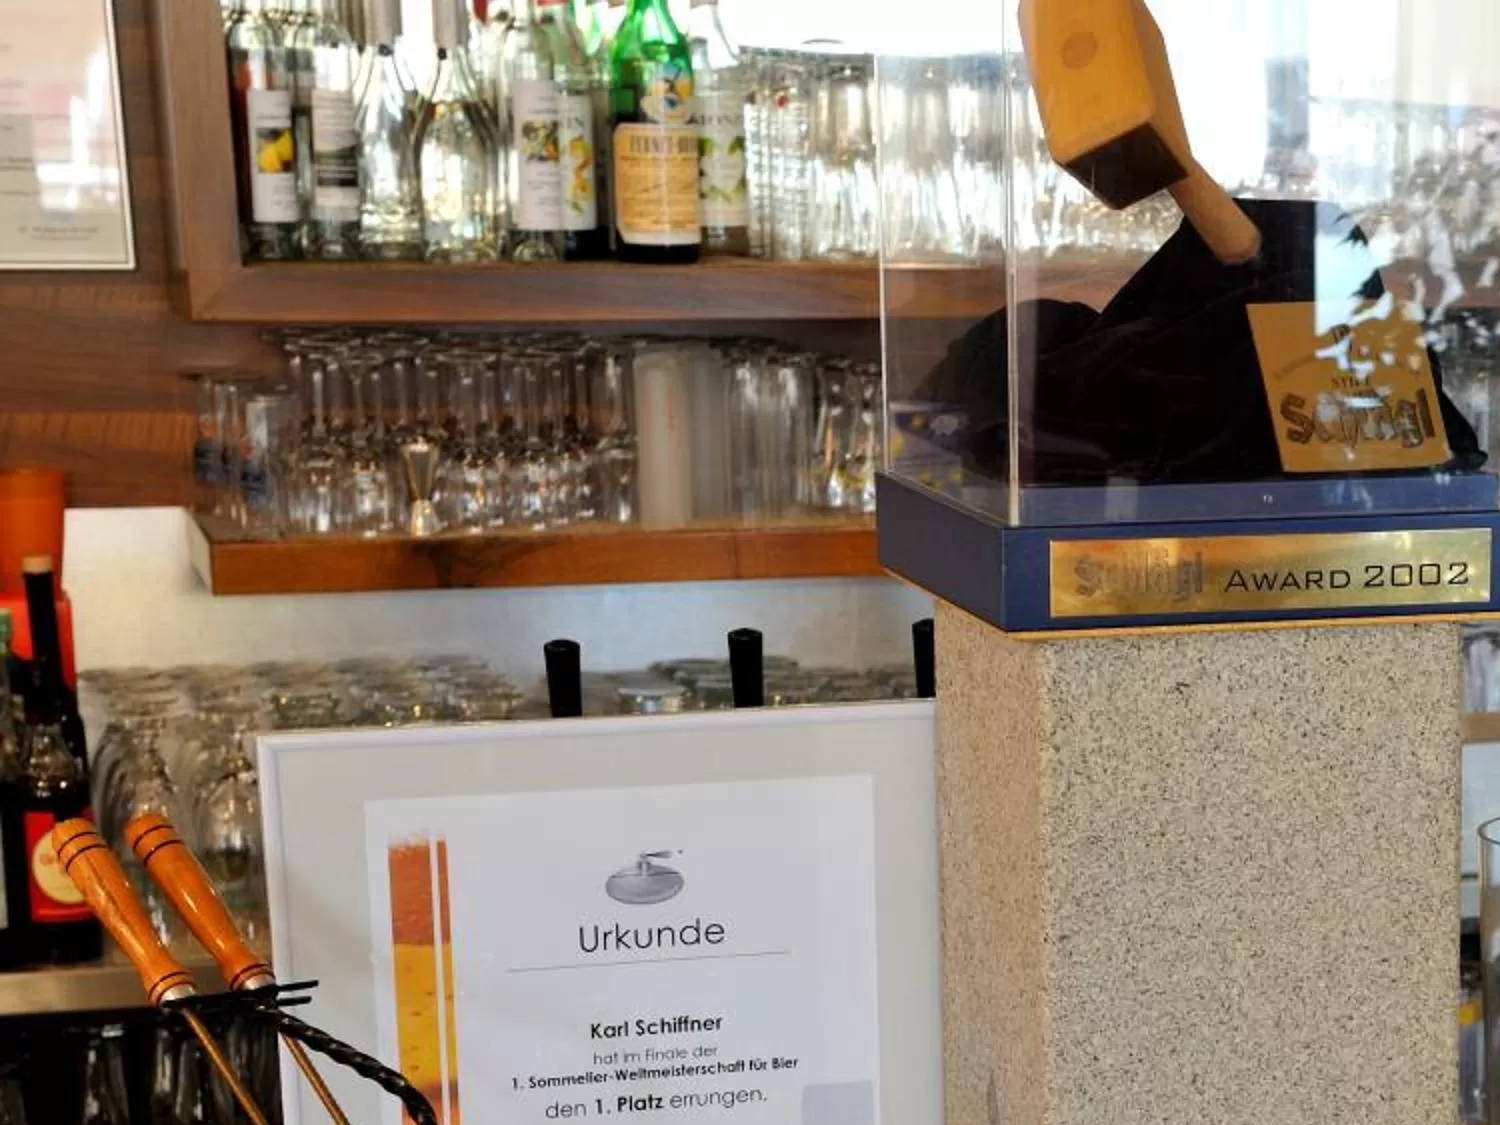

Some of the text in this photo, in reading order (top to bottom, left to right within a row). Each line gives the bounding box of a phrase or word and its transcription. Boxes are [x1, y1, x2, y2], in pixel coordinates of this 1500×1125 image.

[1363, 562, 1470, 588] 2002
[578, 917, 726, 953] Urkunde
[590, 1015, 724, 1040] Karl Schiffner
[593, 1045, 718, 1066] hat im Finale der
[512, 1056, 799, 1091] 1. Sommelier-Weltmeisterschaft für Bier
[545, 1101, 587, 1120] den
[595, 1098, 612, 1116] 1.
[617, 1093, 664, 1113] Platz
